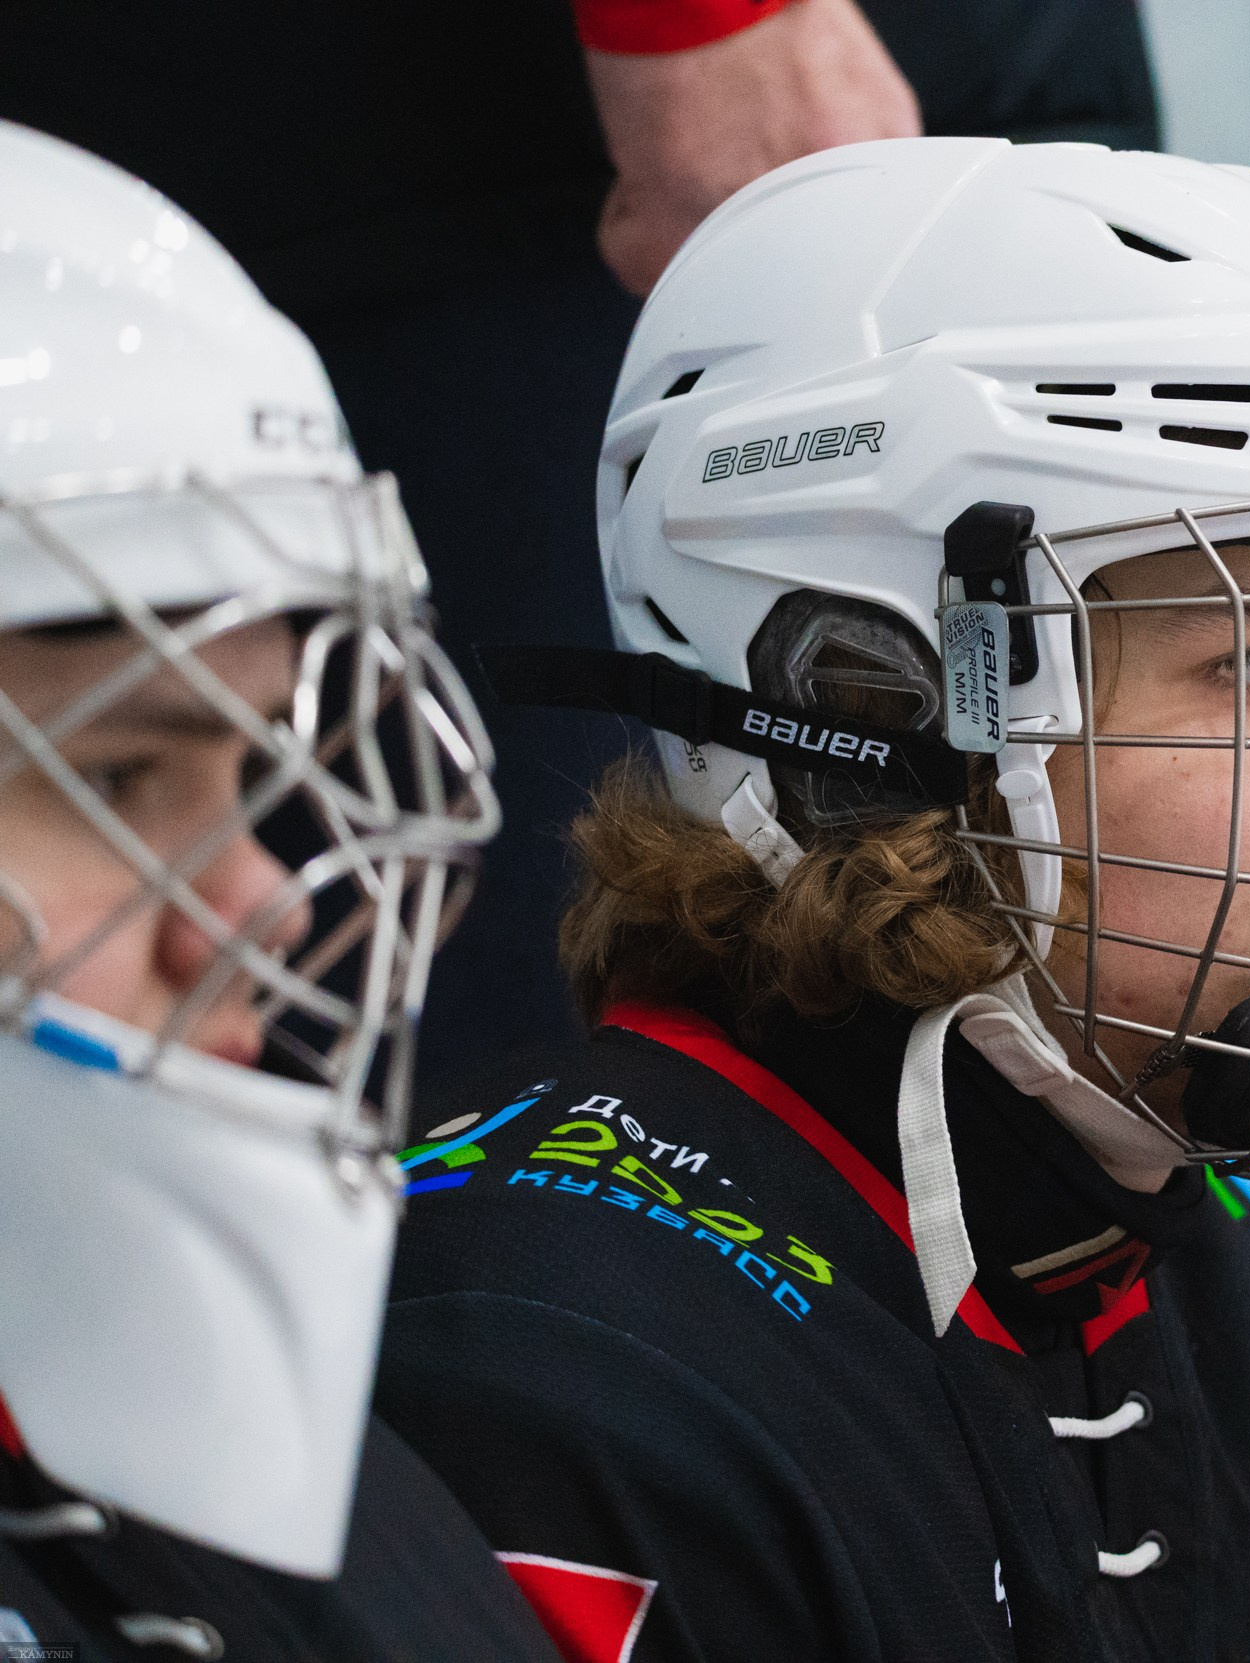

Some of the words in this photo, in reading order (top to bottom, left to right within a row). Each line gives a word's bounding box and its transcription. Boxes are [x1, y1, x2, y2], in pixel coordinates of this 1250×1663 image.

[946, 612, 985, 644] VISION
[947, 608, 976, 632] TRUE
[954, 672, 968, 713] M/M
[967, 647, 979, 708] PROFILE
[971, 712, 980, 724] III
[688, 757, 708, 772] CA
[568, 1095, 710, 1173] Дети
[506, 1169, 812, 1322] КУЗБАСС
